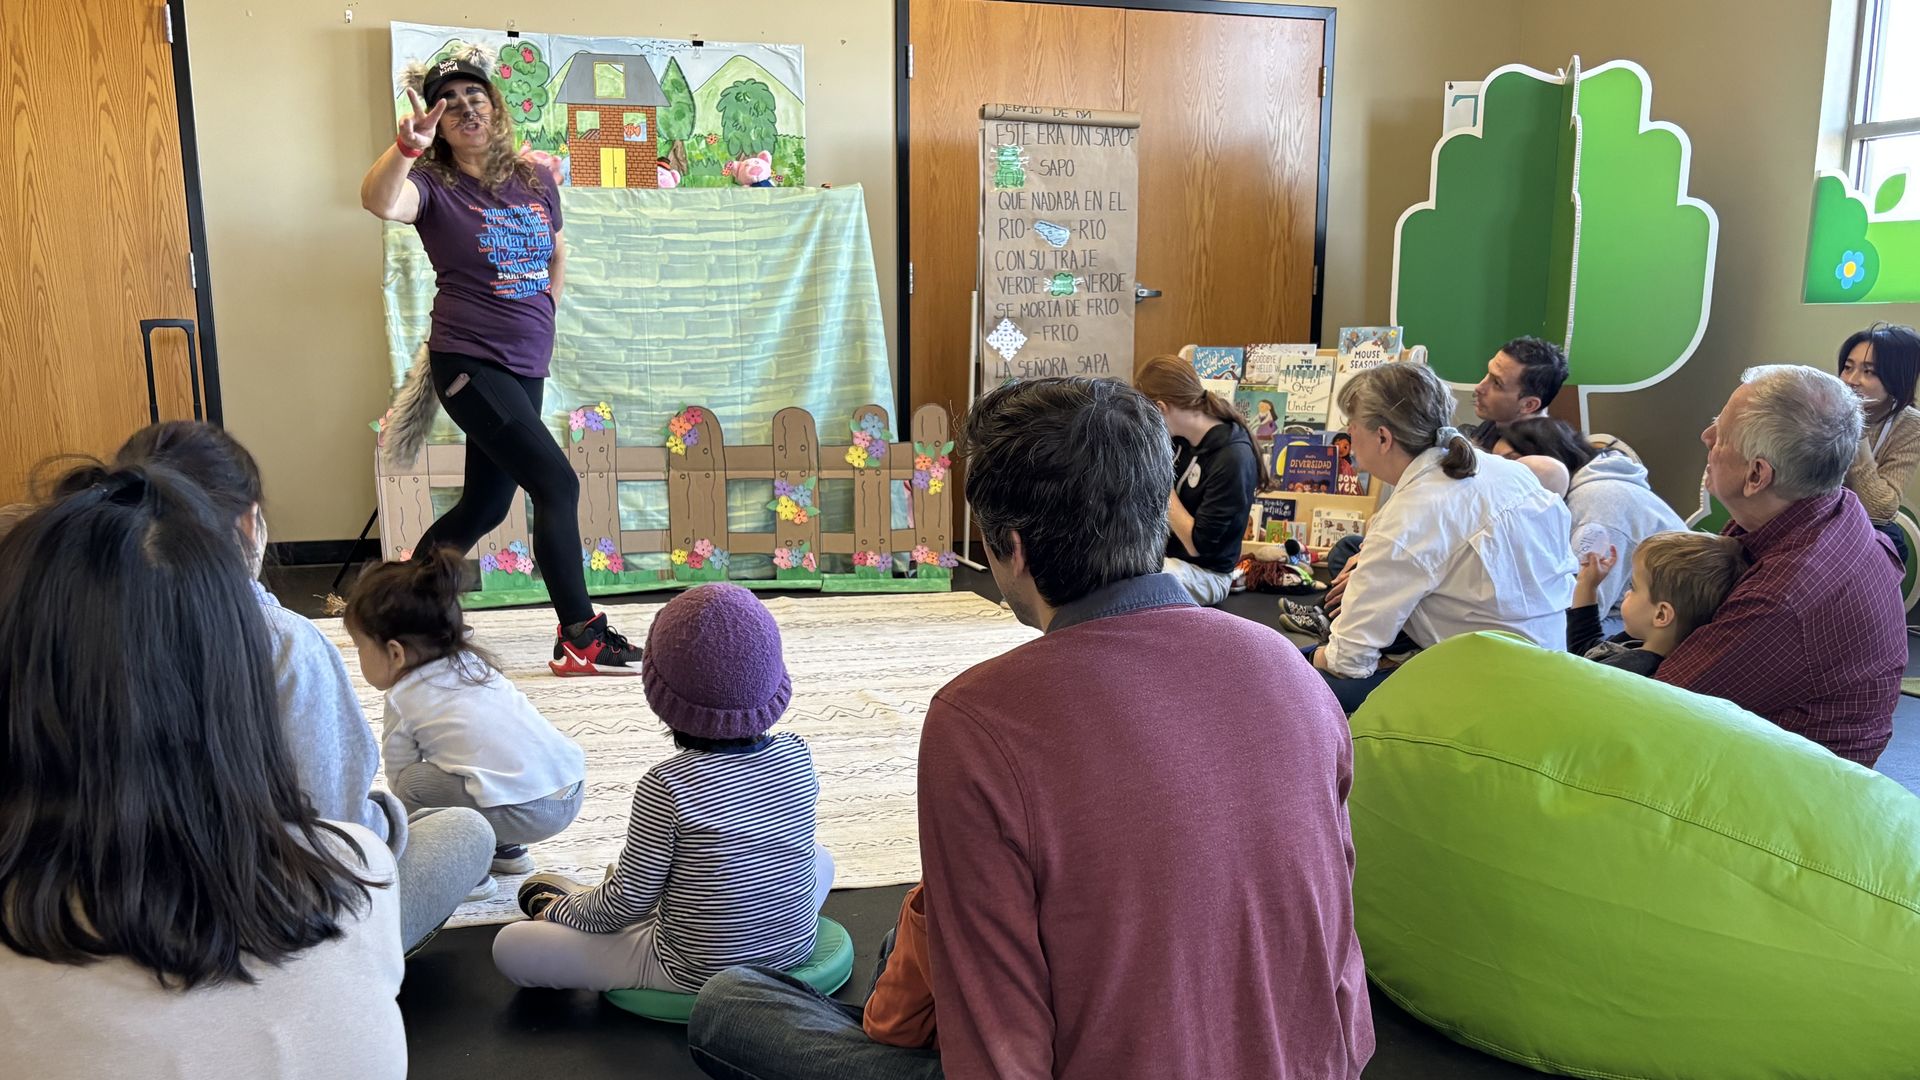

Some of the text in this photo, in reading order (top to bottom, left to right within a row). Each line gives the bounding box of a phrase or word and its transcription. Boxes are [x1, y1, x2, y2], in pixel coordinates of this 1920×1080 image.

[440, 62, 458, 76] kind
[996, 123, 1031, 146] ESTE
[1037, 123, 1066, 146] ERA
[1071, 125, 1091, 146] UN
[1038, 159, 1075, 177] SAPO
[998, 190, 1127, 212] QUE NADABA EN EL
[480, 231, 551, 248] solidaridad
[994, 249, 1099, 271] CON SU TRAJE
[997, 276, 1041, 296] VERDE
[993, 298, 1119, 320] SE MORIA DE FRIO
[1252, 355, 1276, 364] GOODBYE
[1354, 350, 1380, 359] MOUSE
[995, 353, 1110, 379] LA SEÑORA SAPA
[1256, 364, 1274, 373] HELLO
[1292, 382, 1315, 394] Over
[1287, 401, 1315, 412] Under
[1290, 459, 1332, 470] DIVERSIDAD
